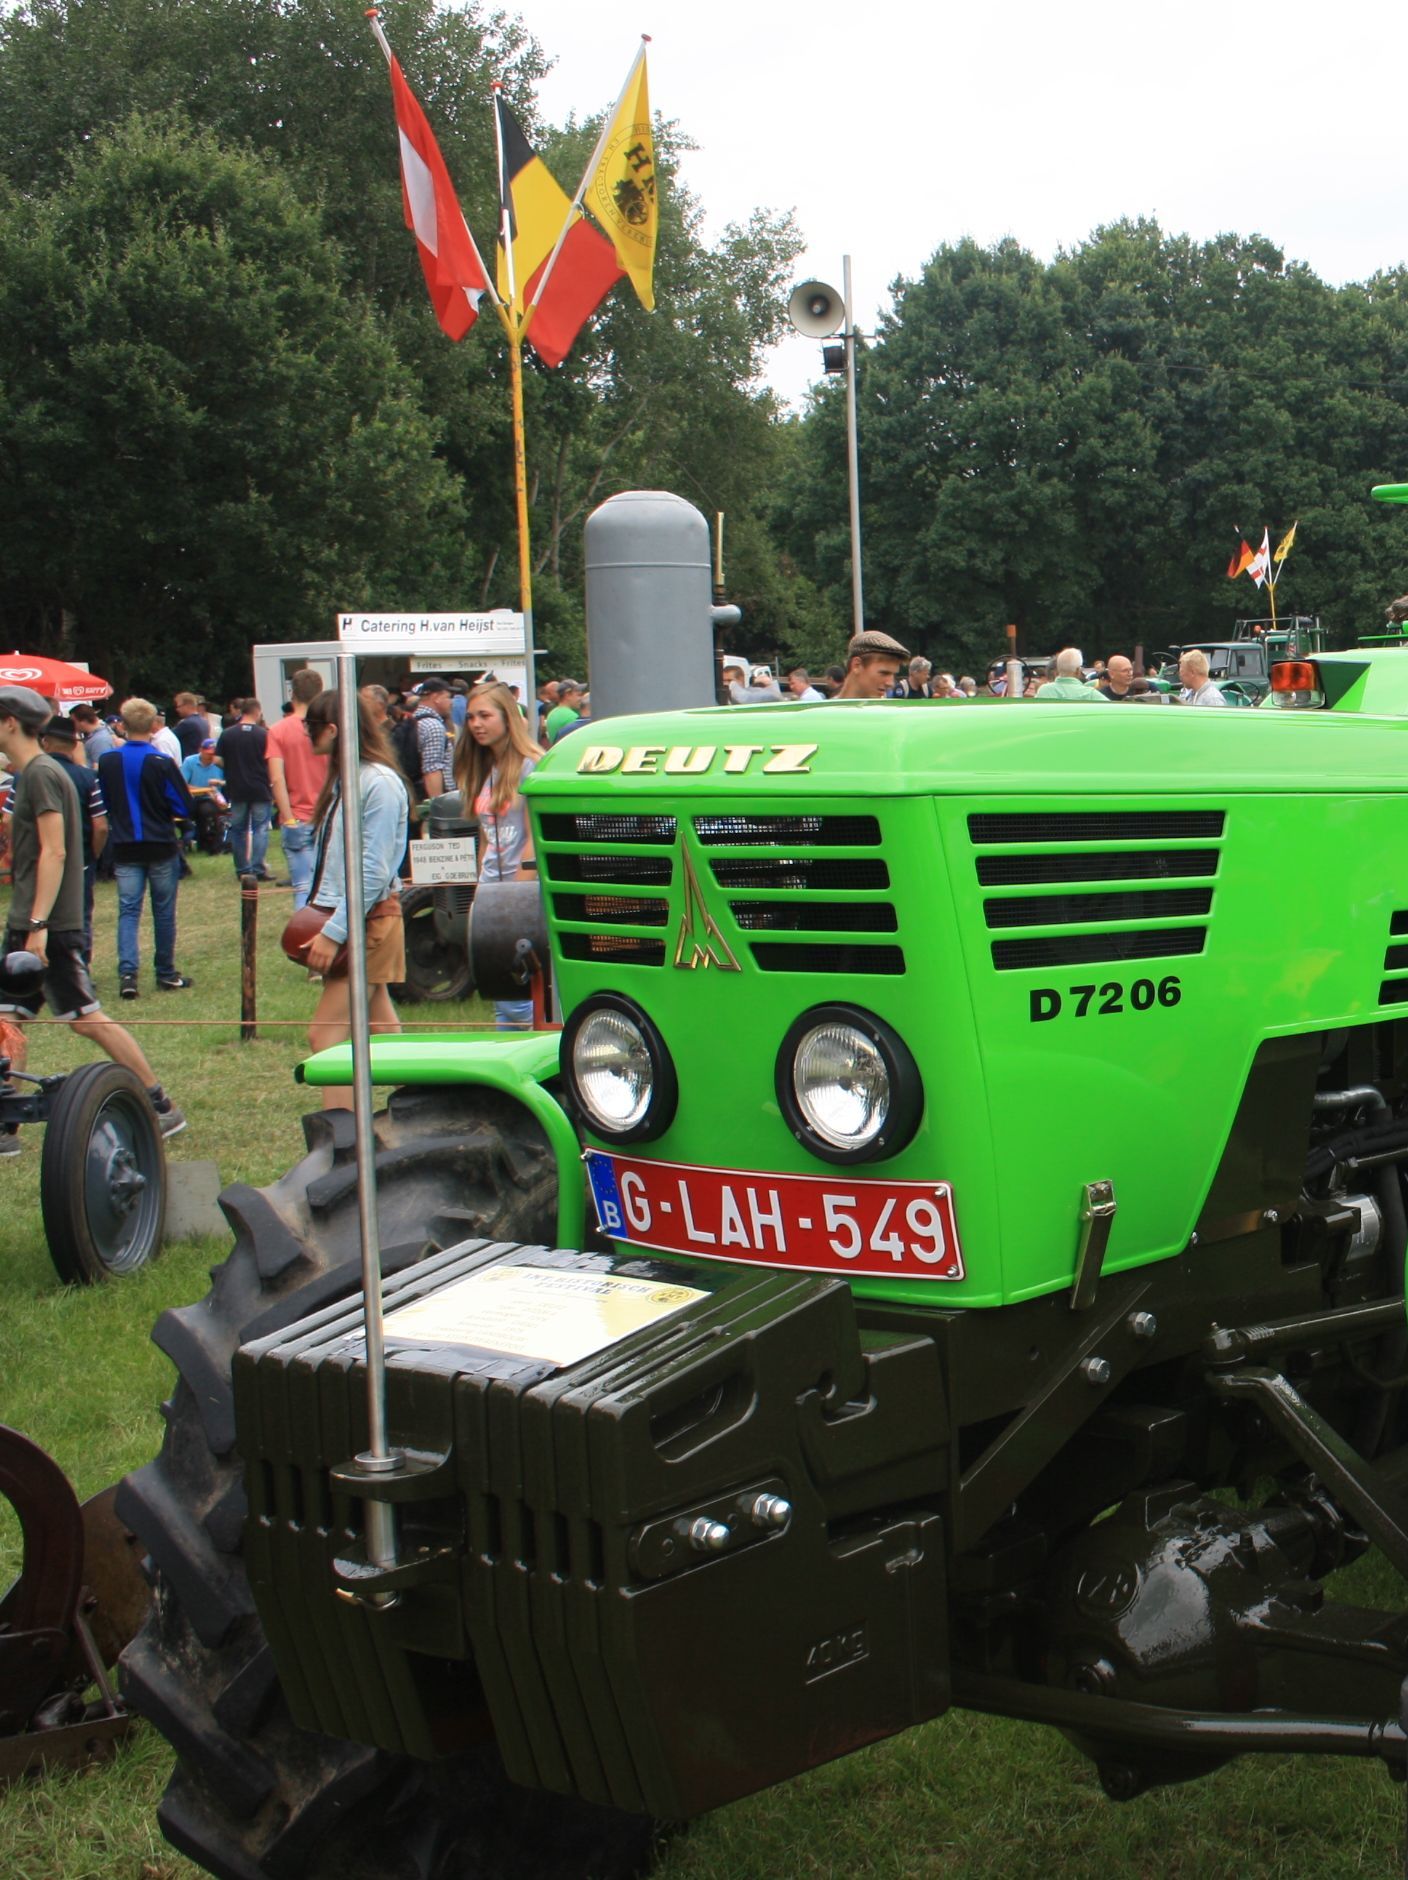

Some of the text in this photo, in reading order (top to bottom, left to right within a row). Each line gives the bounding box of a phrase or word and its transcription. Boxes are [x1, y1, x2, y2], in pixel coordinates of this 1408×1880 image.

[361, 619, 416, 635] Catering
[420, 619, 455, 633] H.van
[459, 618, 494, 634] Heijst
[416, 661, 442, 669] Frites
[458, 660, 487, 669] Snacks
[576, 743, 818, 775] DEUTZ
[412, 843, 444, 851] FERGUSON
[602, 1200, 622, 1229] B
[620, 1171, 946, 1265] G-LAH-549
